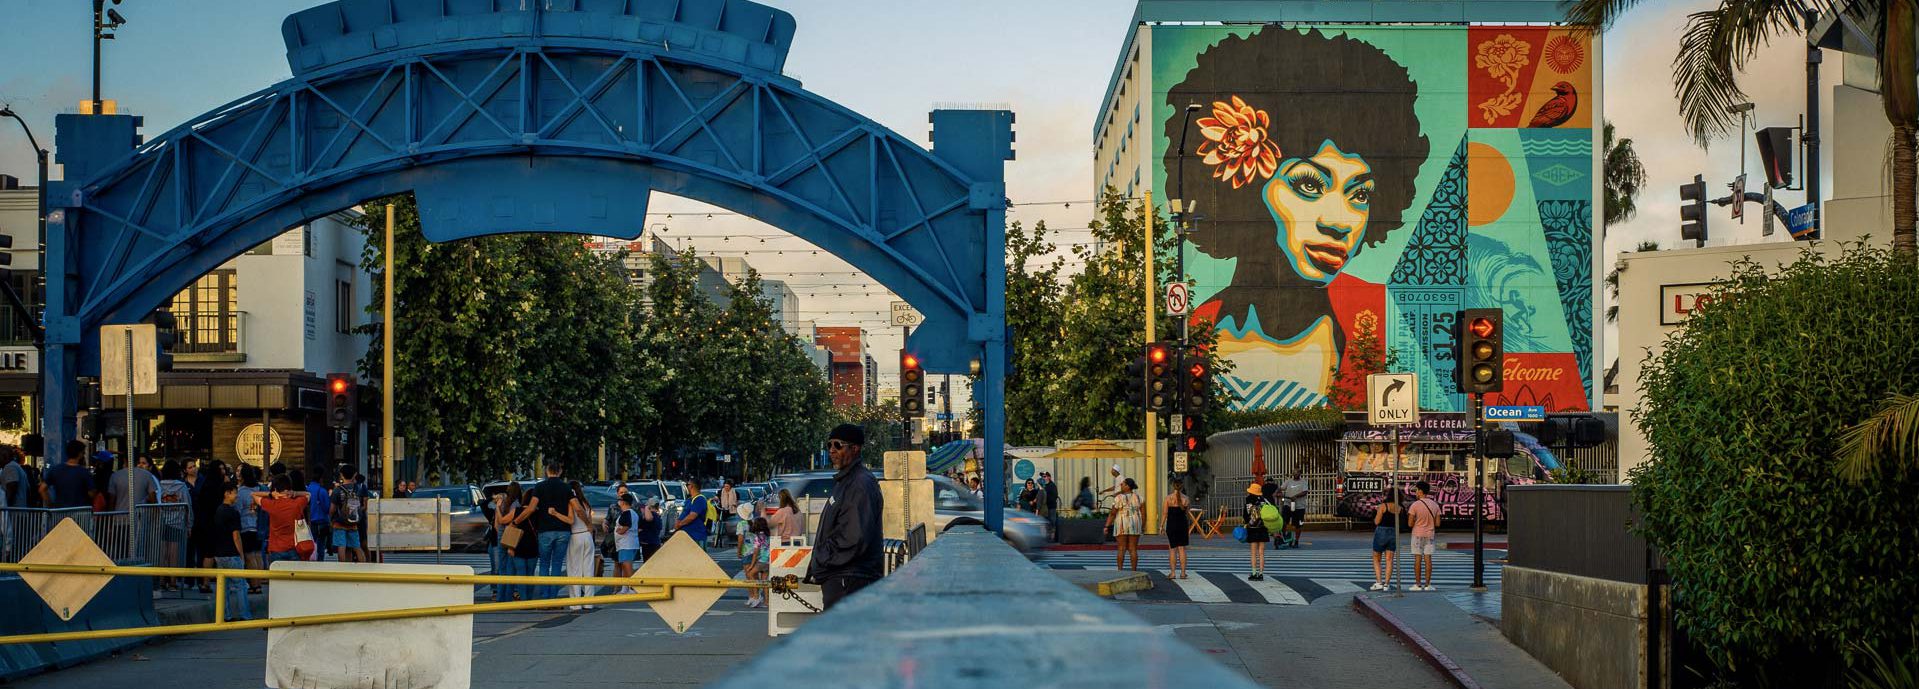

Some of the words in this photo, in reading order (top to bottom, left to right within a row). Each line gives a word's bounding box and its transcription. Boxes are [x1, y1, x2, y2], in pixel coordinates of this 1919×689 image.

[1791, 207, 1813, 228] Colorado
[1409, 341, 1417, 372] ONICA,
[1503, 357, 1563, 381] elcome
[1379, 409, 1408, 418] ONLY
[1488, 407, 1522, 417] Ocean
[1424, 420, 1438, 429] ICE
[243, 442, 274, 455] GRILE
[1352, 481, 1379, 489] AFTERS
[1440, 504, 1488, 516] FTERS
